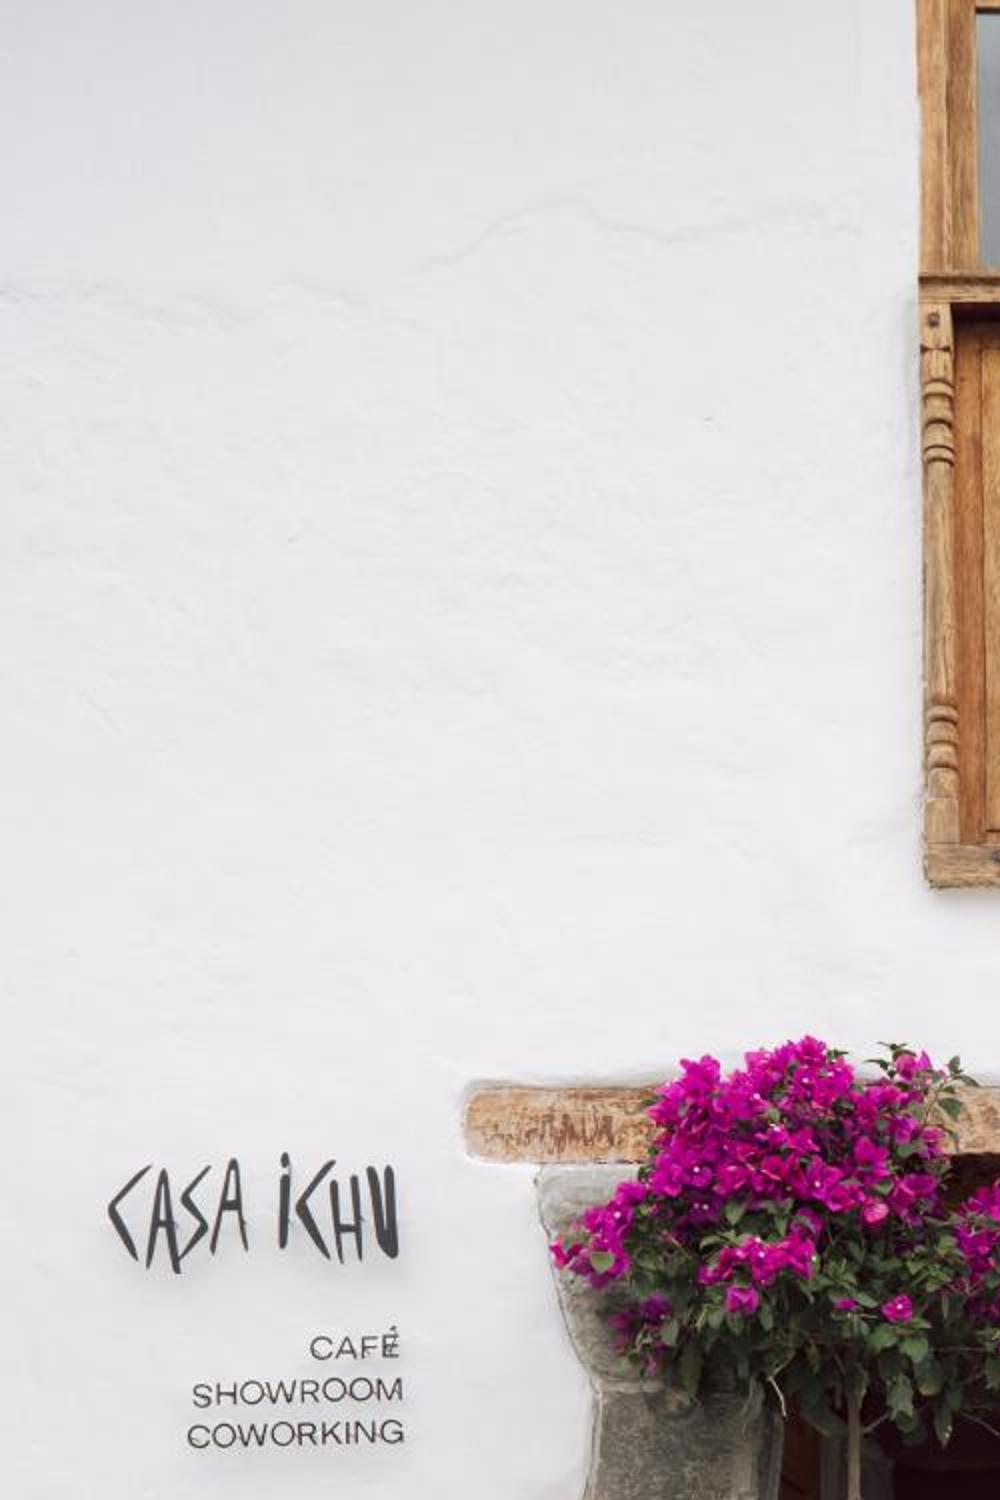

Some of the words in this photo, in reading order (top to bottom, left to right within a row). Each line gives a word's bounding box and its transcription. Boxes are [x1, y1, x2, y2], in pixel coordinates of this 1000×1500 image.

[107, 1156, 249, 1275] CASA
[309, 1325, 400, 1361] CAFÉ
[192, 1376, 403, 1409] SHOWROOM
[187, 1418, 404, 1449] COWORKING
